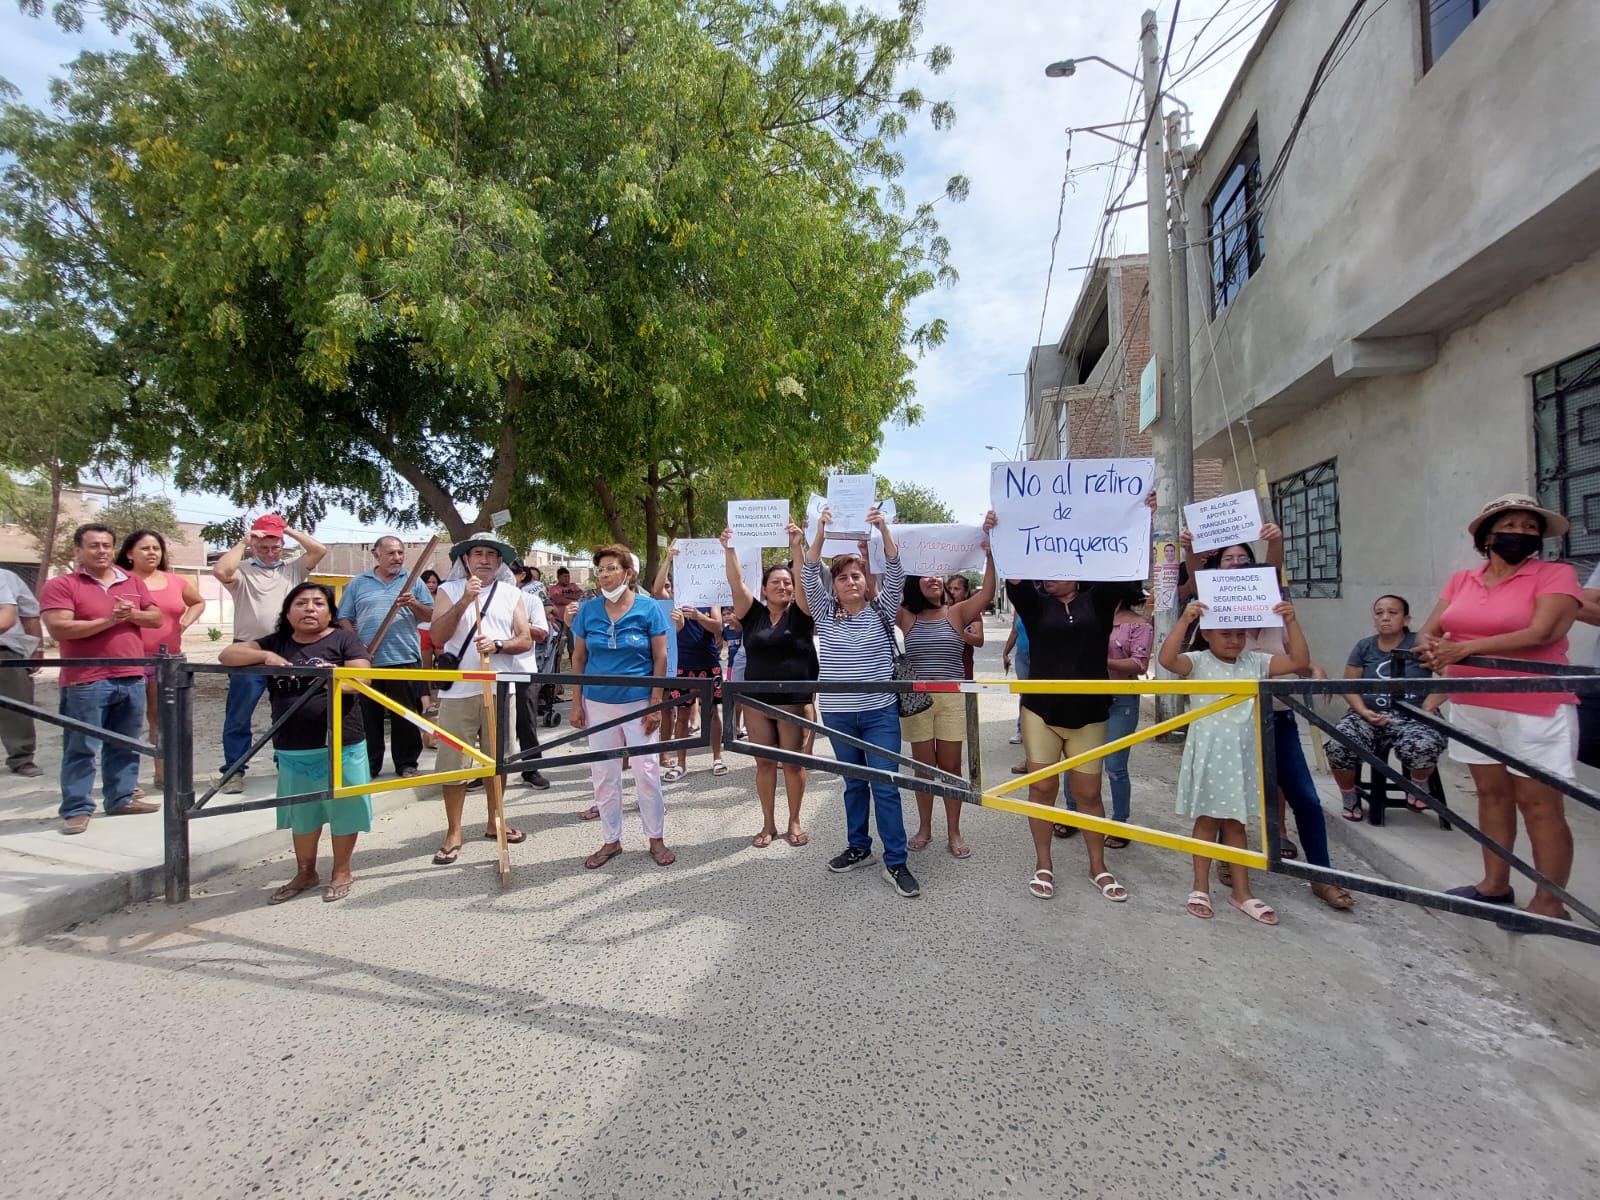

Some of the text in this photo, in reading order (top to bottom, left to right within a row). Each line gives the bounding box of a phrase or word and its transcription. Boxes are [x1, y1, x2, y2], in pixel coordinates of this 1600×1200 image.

[1005, 462, 1143, 498] No al retiro
[1053, 501, 1072, 520] de
[1206, 510, 1225, 520] APOYE
[1196, 526, 1231, 539] SEGURIDAD
[1241, 521, 1254, 529] LOS
[1199, 515, 1243, 530] TRANQUILIDAD
[1018, 525, 1129, 564] Tranqueras
